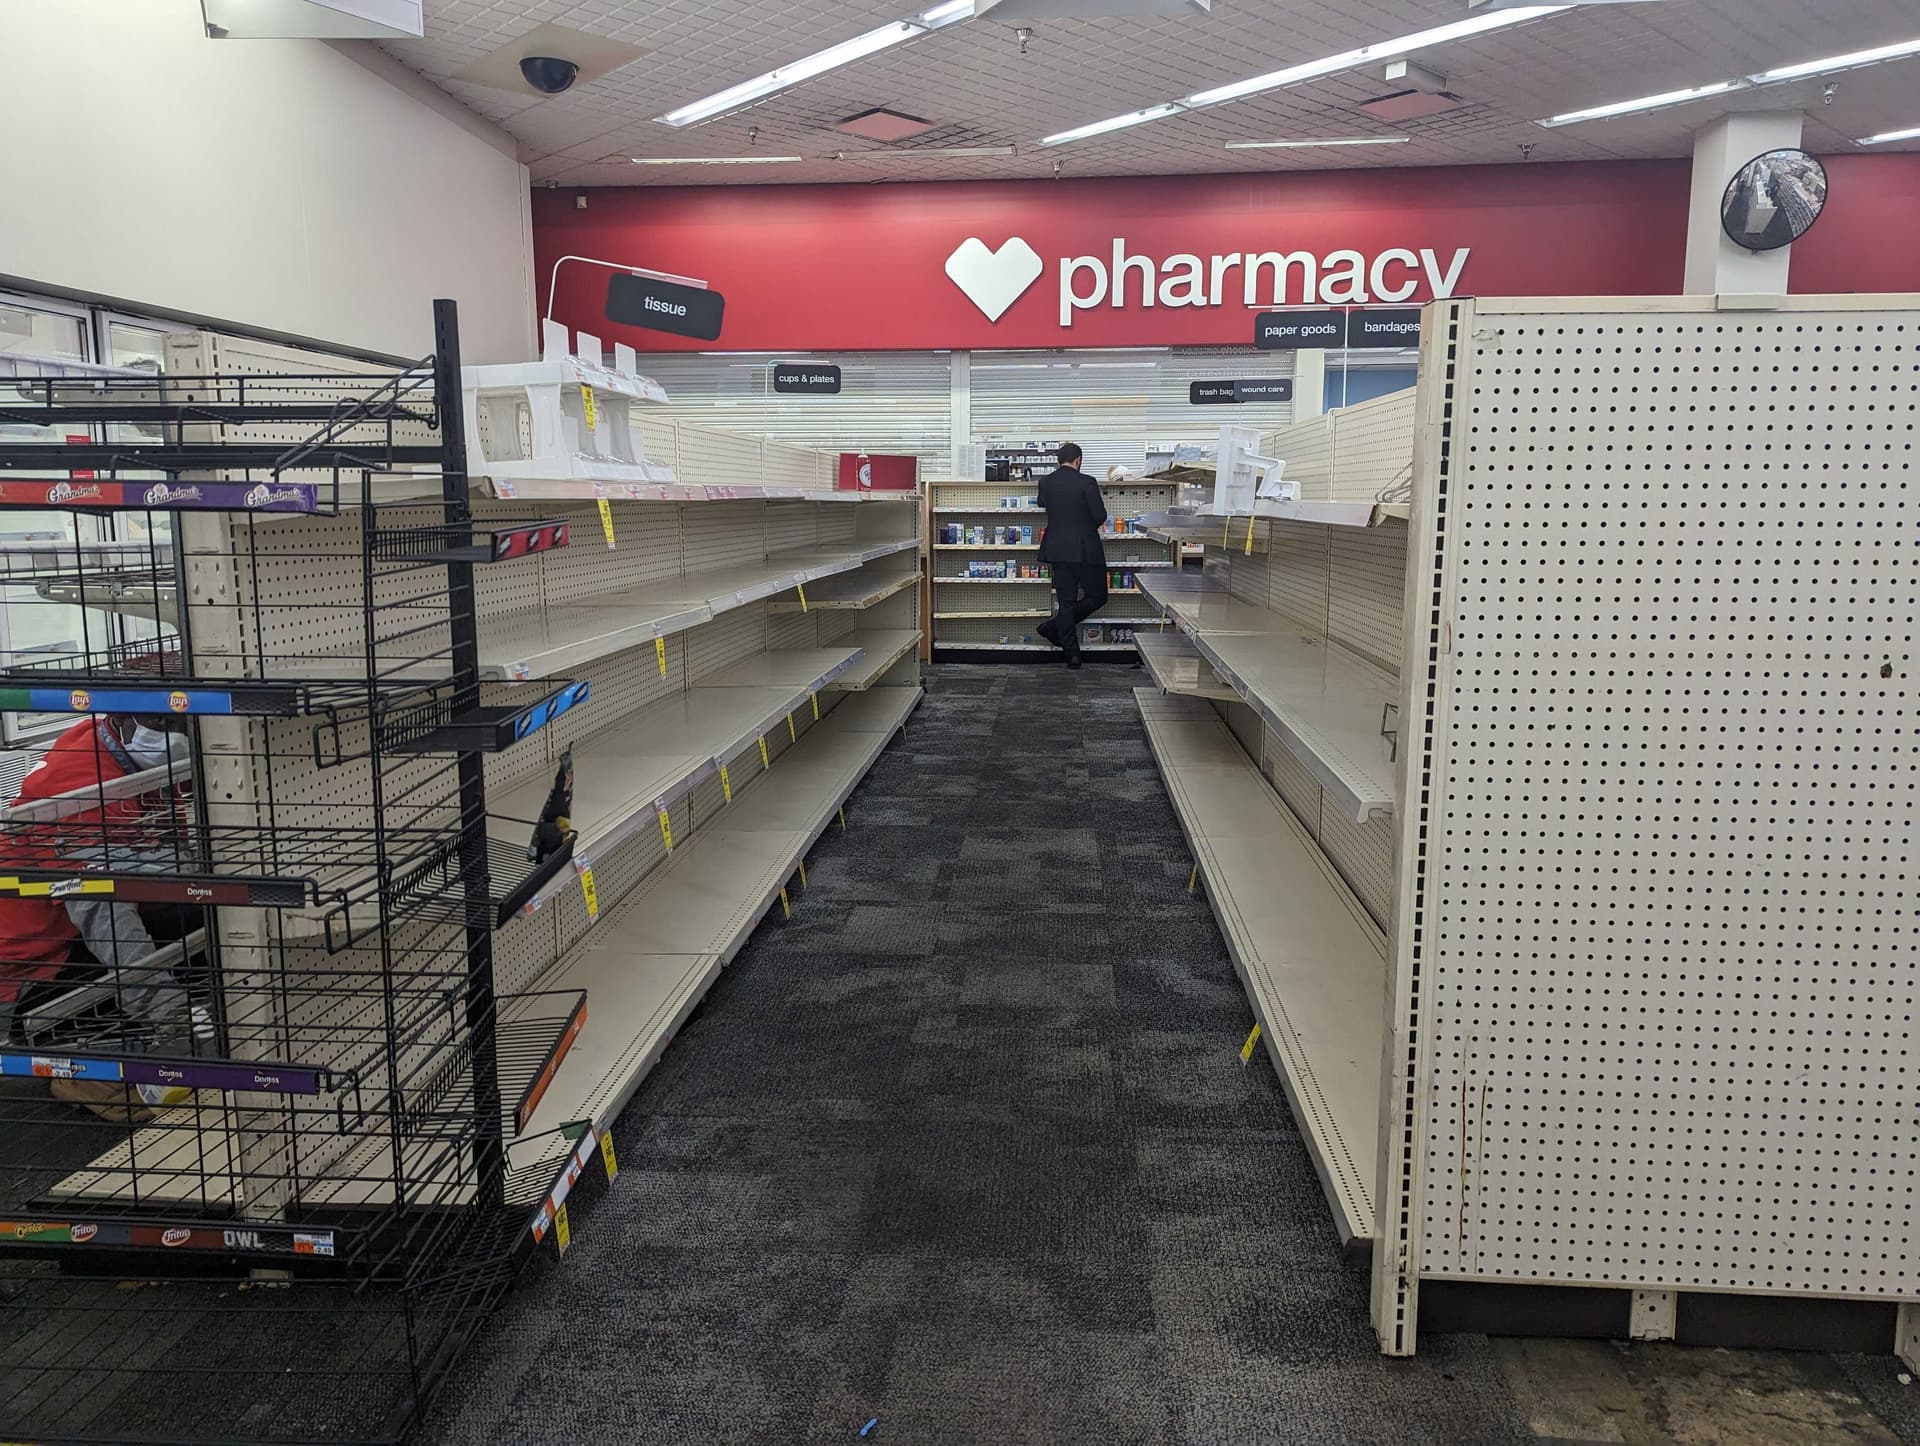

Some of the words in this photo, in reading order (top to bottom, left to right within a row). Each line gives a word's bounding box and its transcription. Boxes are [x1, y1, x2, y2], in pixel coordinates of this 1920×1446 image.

[1059, 238, 1470, 327] pharmacy
[643, 296, 687, 316] tissue
[1264, 325, 1297, 338] paper
[1301, 323, 1337, 337] goods
[1364, 321, 1421, 334] bandages
[778, 375, 799, 384] cups
[801, 374, 808, 383] &
[809, 374, 835, 384] plates
[1199, 388, 1218, 396] trash
[1219, 388, 1234, 397] bag
[187, 887, 213, 897] Doritos
[158, 1069, 183, 1079] Doritos
[254, 1074, 280, 1085] Doritos
